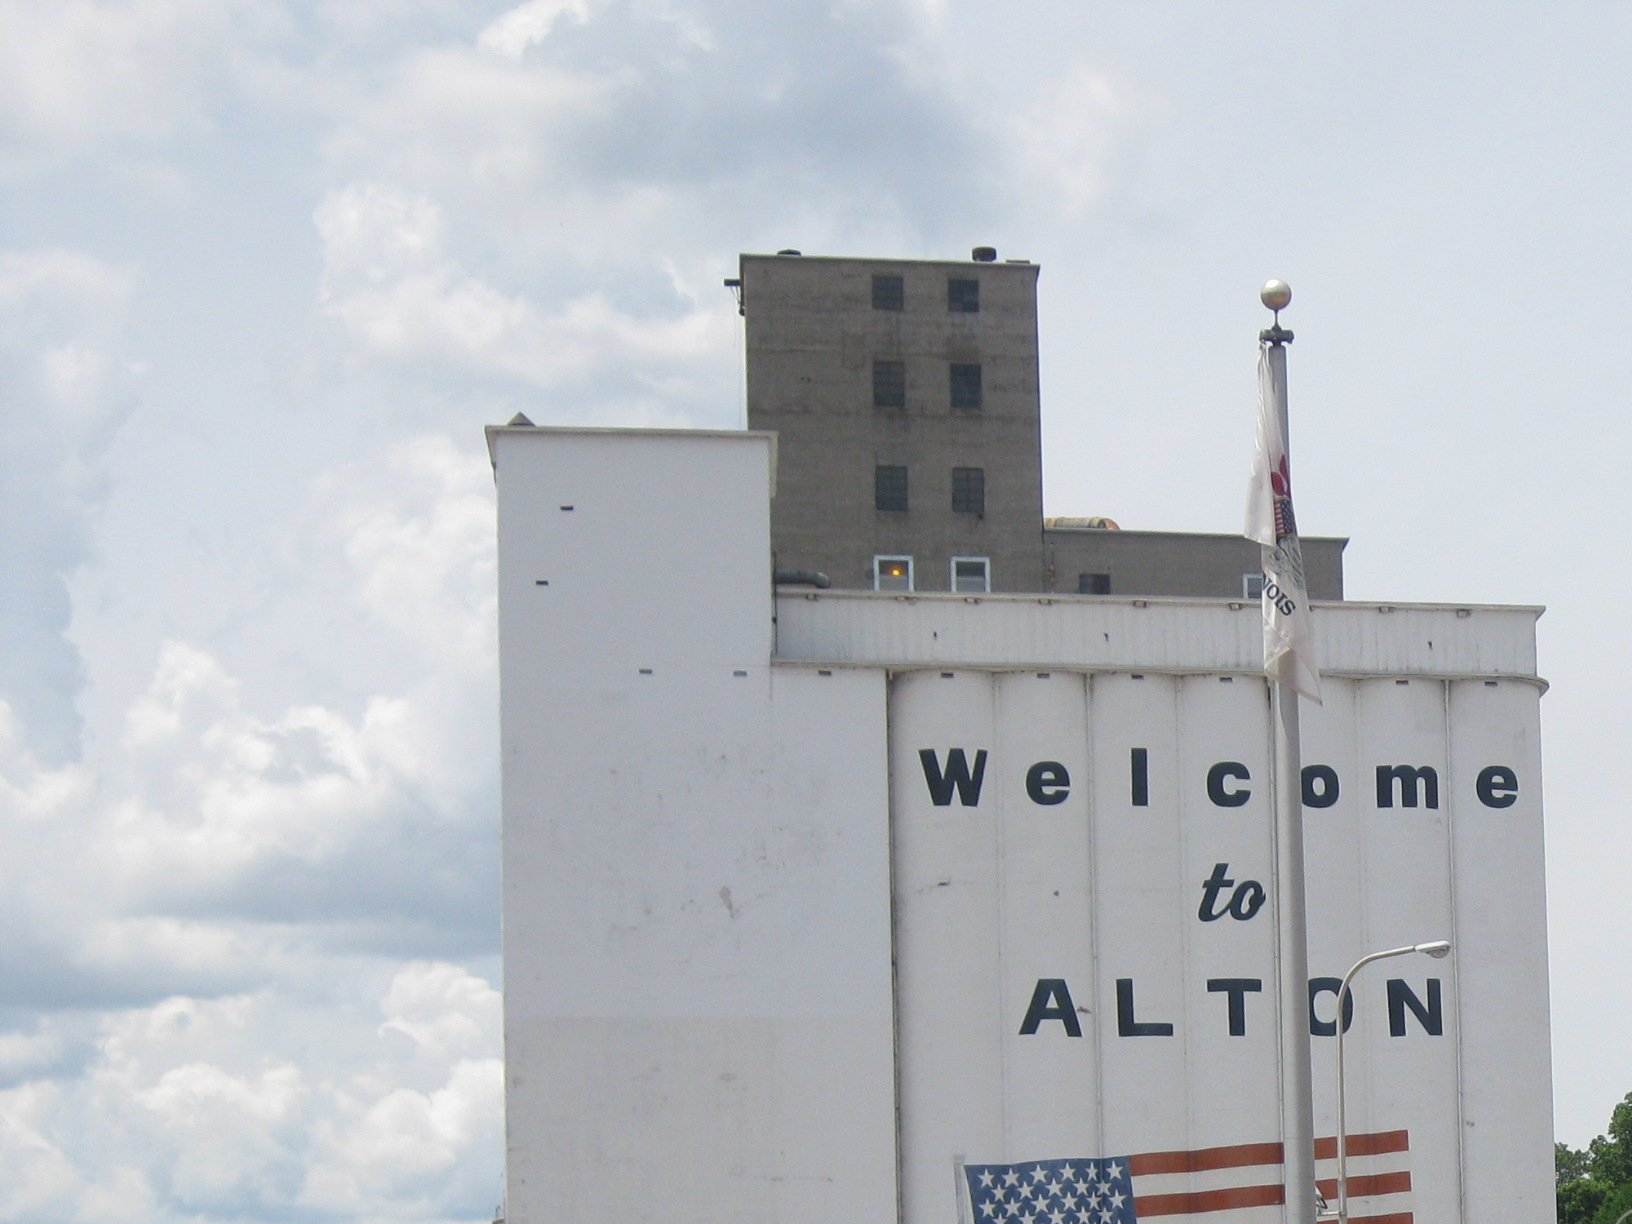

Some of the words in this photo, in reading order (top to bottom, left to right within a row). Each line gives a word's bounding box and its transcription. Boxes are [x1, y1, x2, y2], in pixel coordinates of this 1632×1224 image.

[918, 747, 1519, 810] Welcome
[1198, 863, 1266, 922] to
[1018, 977, 1444, 1037] ALTON
